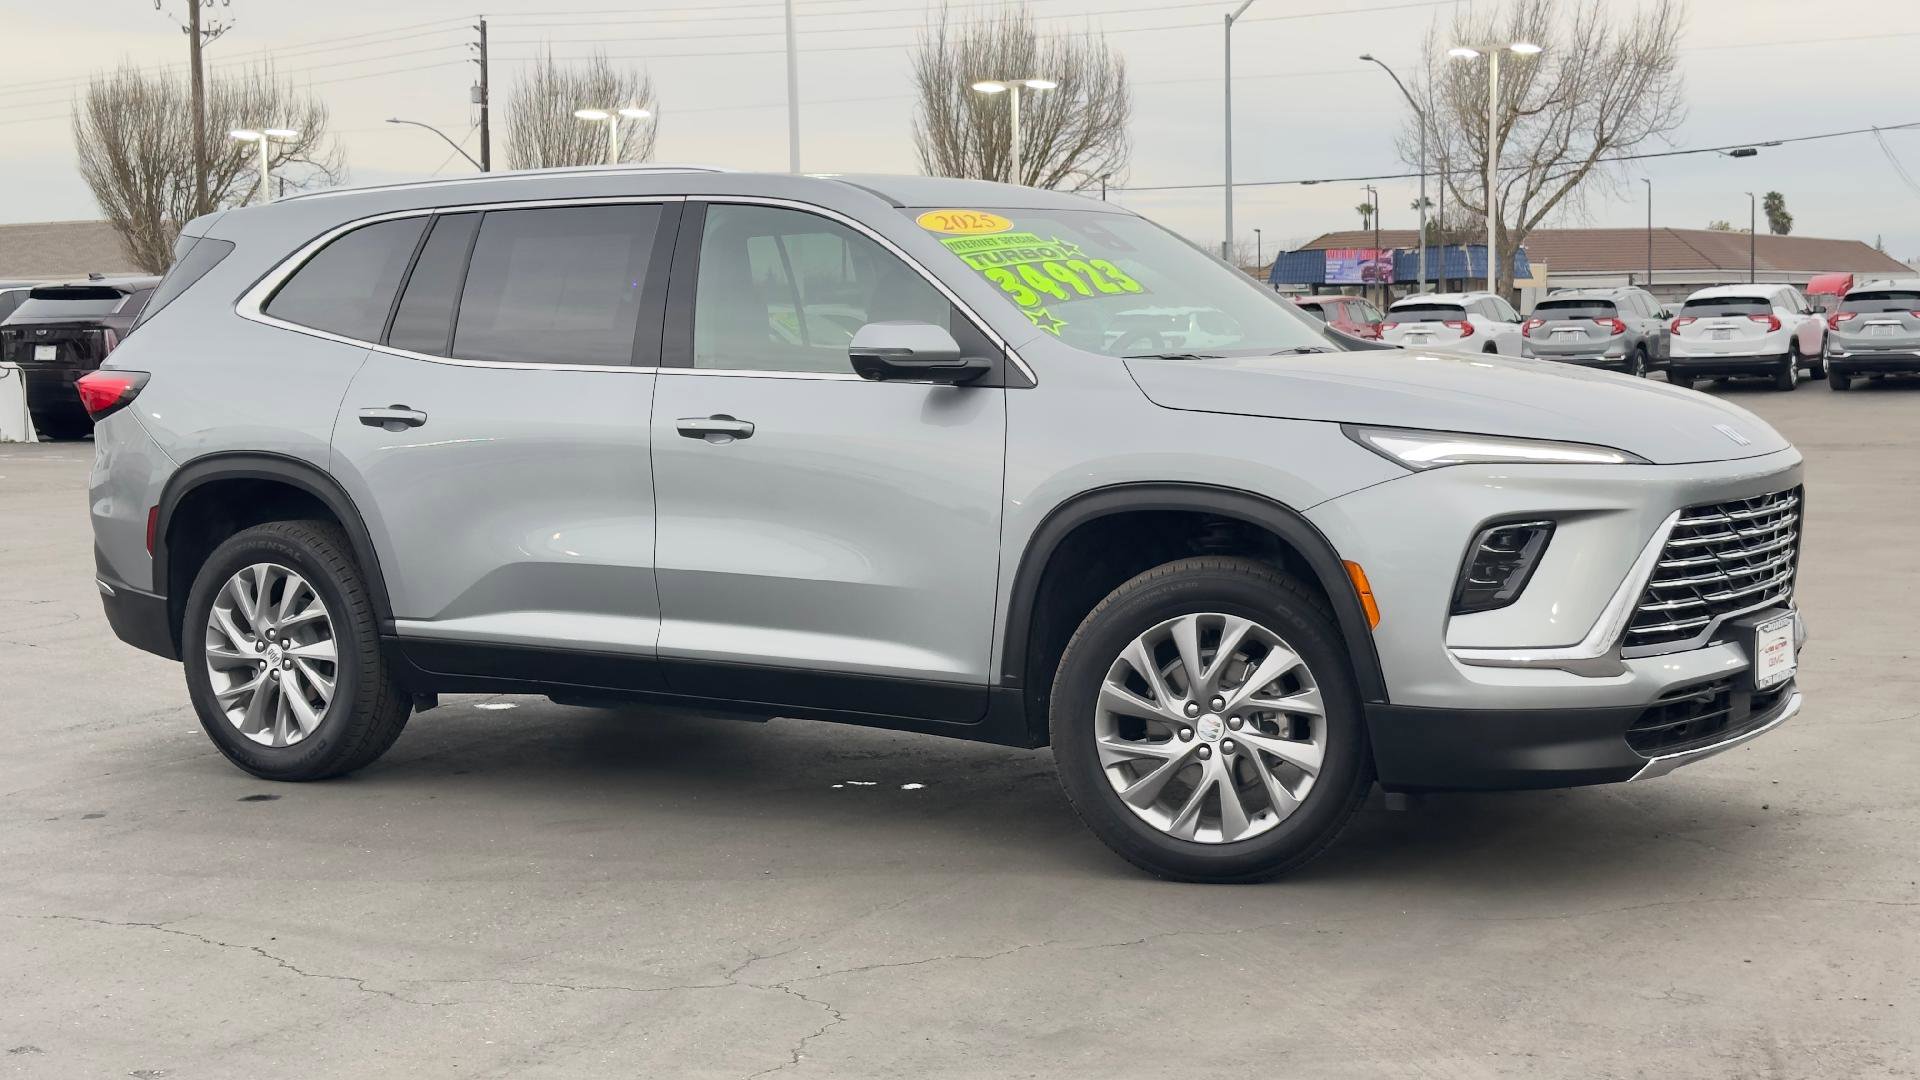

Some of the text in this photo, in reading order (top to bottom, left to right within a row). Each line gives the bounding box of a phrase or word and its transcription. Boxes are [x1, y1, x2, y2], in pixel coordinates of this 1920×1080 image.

[935, 214, 995, 231] 2025
[946, 235, 1042, 251] INTERNET SPECIAL
[966, 246, 1058, 267] TURBO
[983, 259, 1144, 307] 34923
